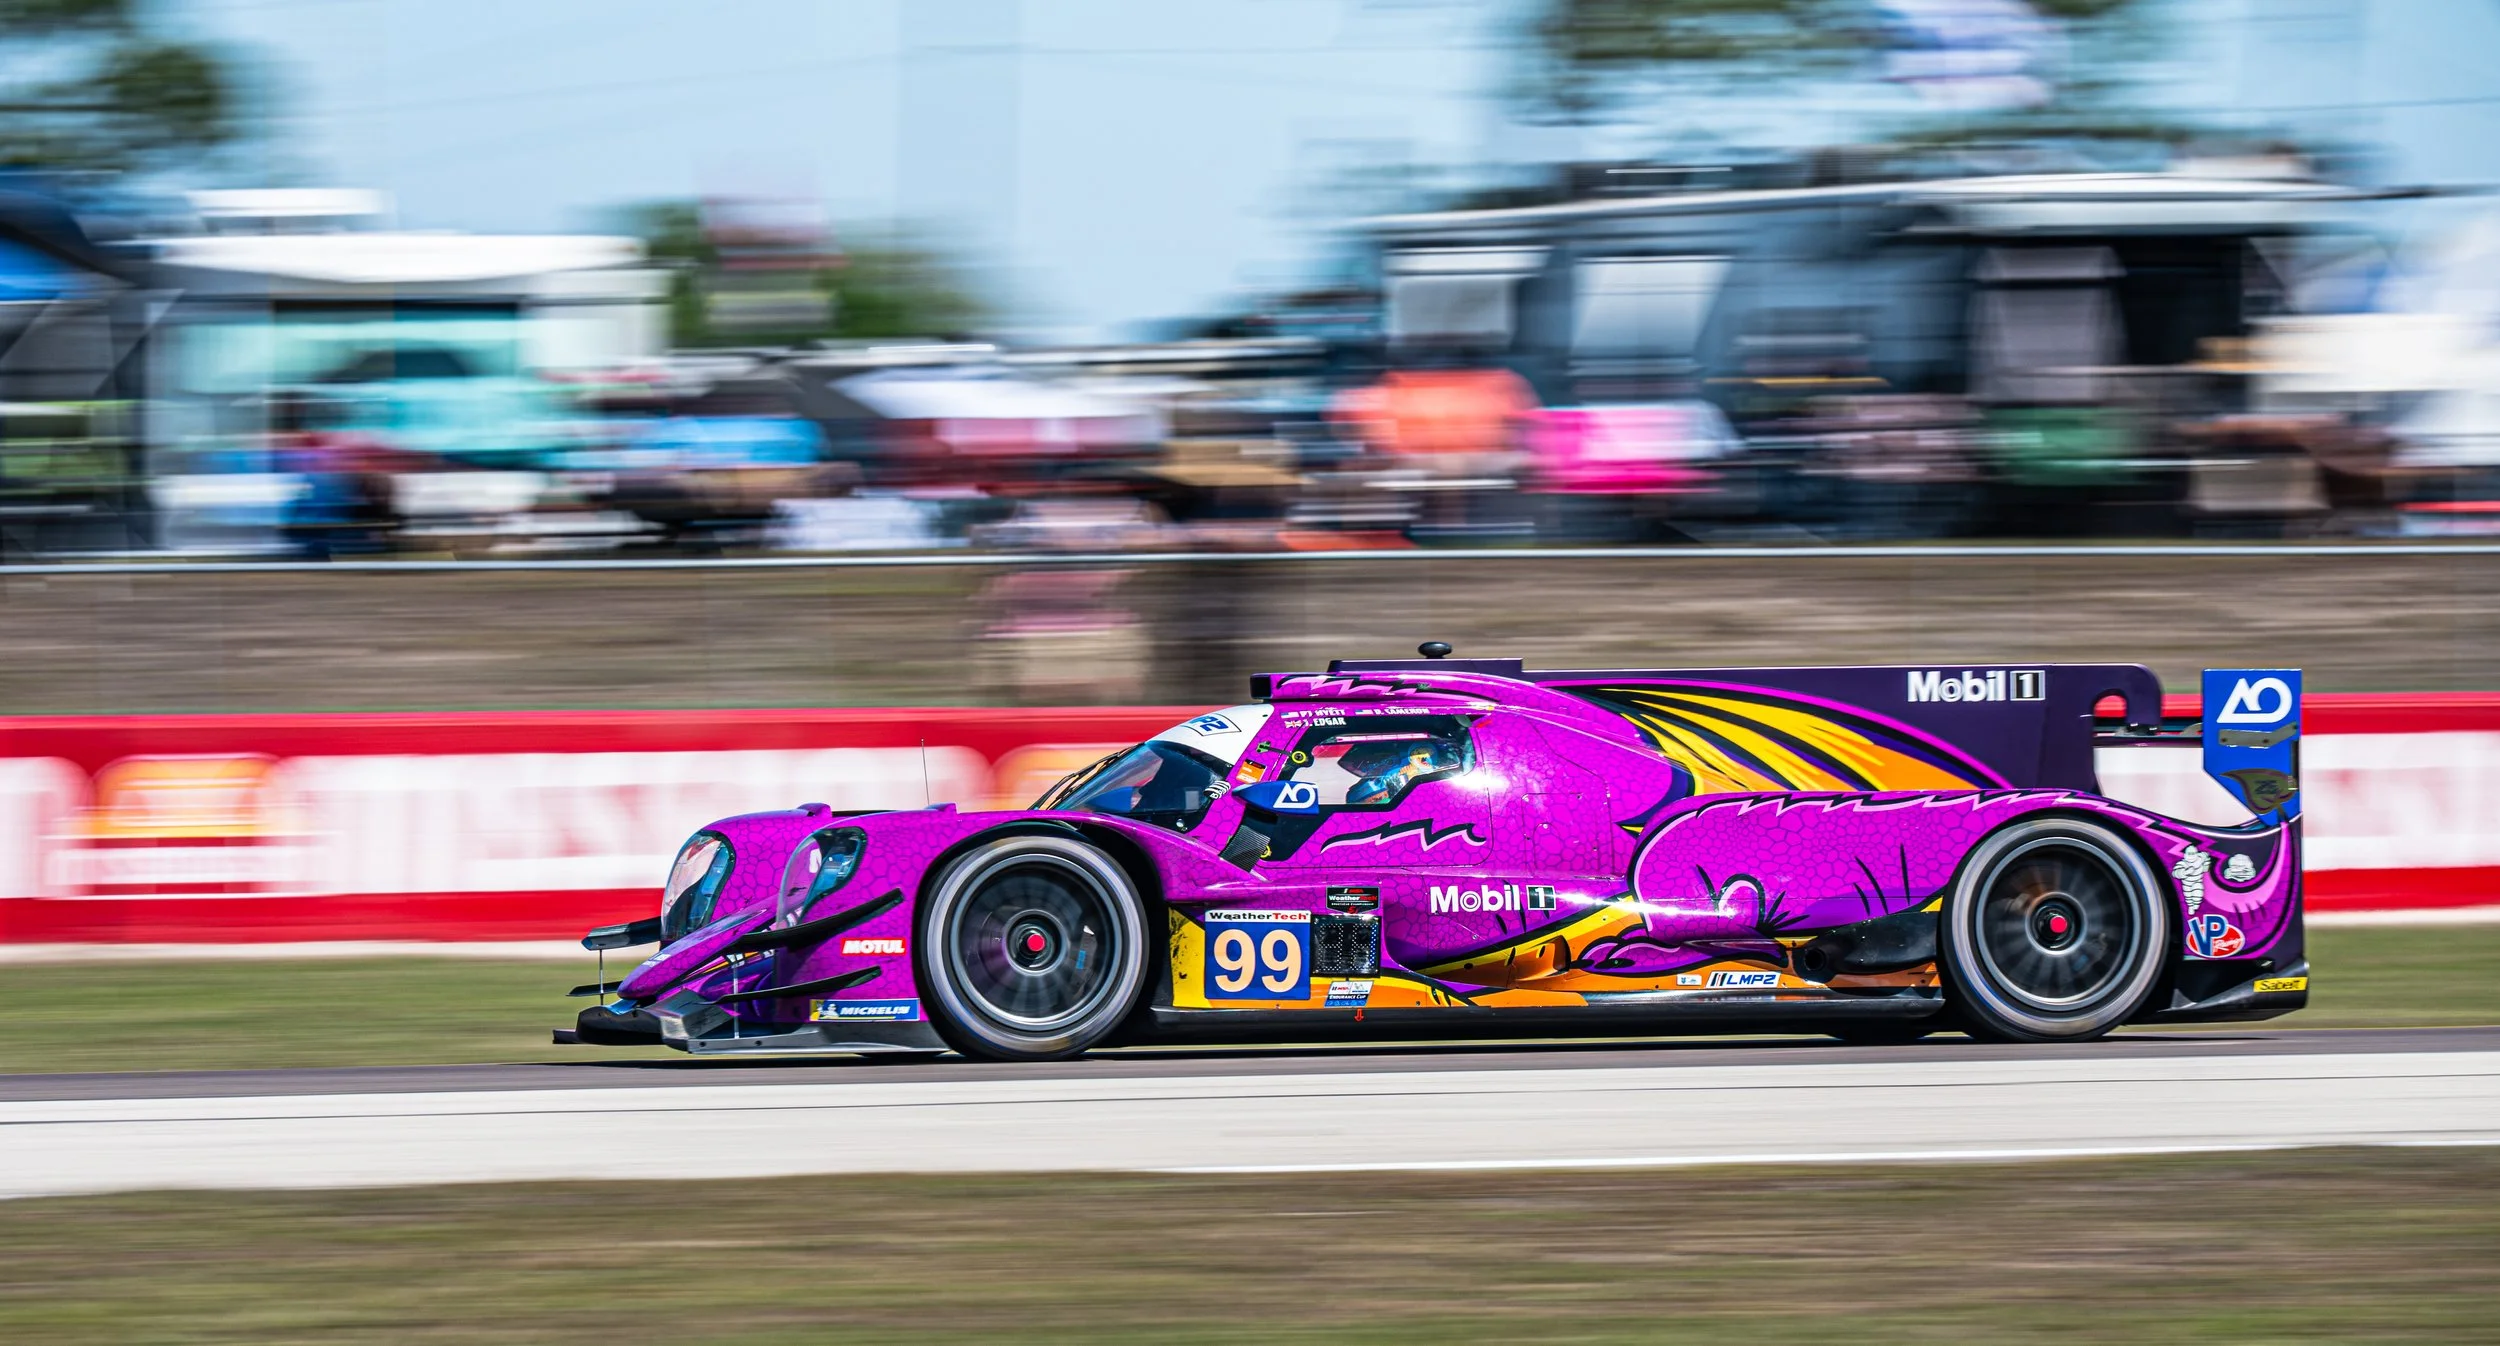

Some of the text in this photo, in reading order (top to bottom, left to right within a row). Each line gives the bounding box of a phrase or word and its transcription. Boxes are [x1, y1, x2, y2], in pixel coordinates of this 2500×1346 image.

[1908, 671, 2006, 702] Mobil
[1313, 717, 1347, 727] EDGAR
[1430, 884, 1521, 914] Mobil
[1209, 912, 1309, 921] WeatherTech
[2187, 914, 2228, 956] VP
[842, 940, 906, 954] MOTUL
[1213, 928, 1302, 993] 99
[1726, 974, 1777, 985] LMP2
[840, 1005, 911, 1016] MICHELIN
